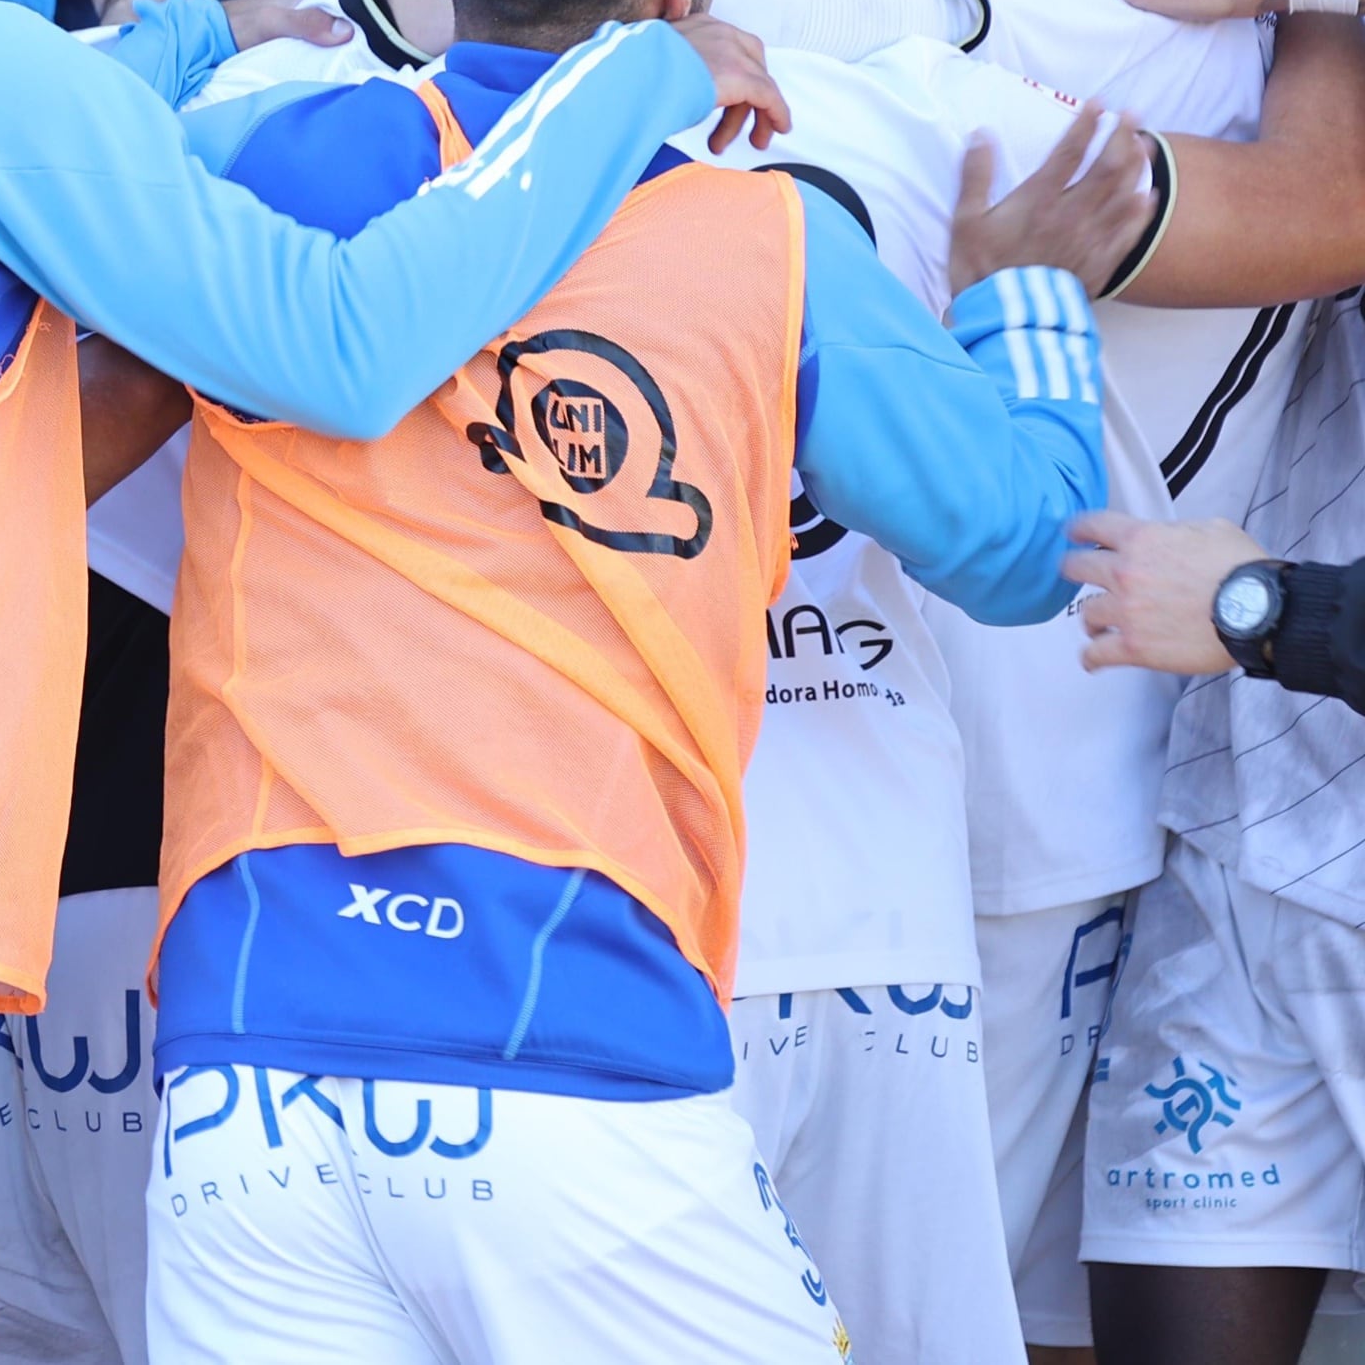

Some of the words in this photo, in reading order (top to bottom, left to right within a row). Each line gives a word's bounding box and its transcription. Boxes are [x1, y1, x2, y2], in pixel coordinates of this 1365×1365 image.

[550, 400, 603, 433] UNI
[337, 883, 465, 939] XCD
[28, 1108, 142, 1133] CLUB
[171, 1163, 338, 1218] DRIVE
[1107, 1164, 1281, 1190] artromed
[1145, 1198, 1186, 1211] sport
[1193, 1196, 1238, 1209] clinic
